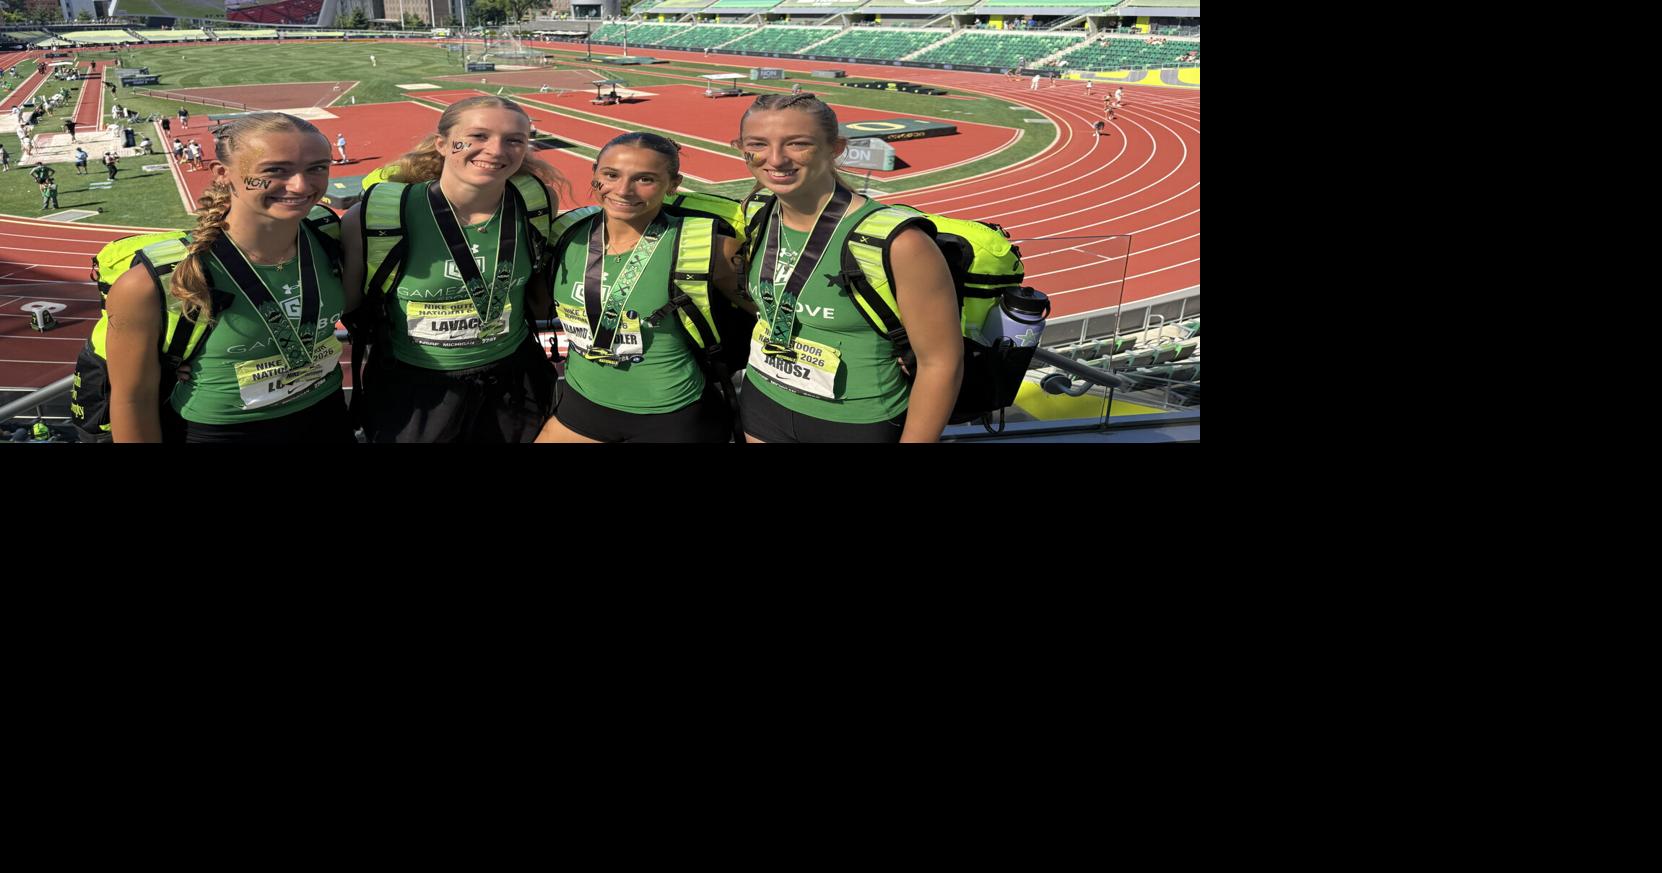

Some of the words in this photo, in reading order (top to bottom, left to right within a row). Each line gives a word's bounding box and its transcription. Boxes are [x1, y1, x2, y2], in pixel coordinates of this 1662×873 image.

[847, 148, 871, 160] ON
[431, 318, 480, 332] LAVAC
[255, 360, 283, 371] NIKE
[800, 354, 825, 368] 2026
